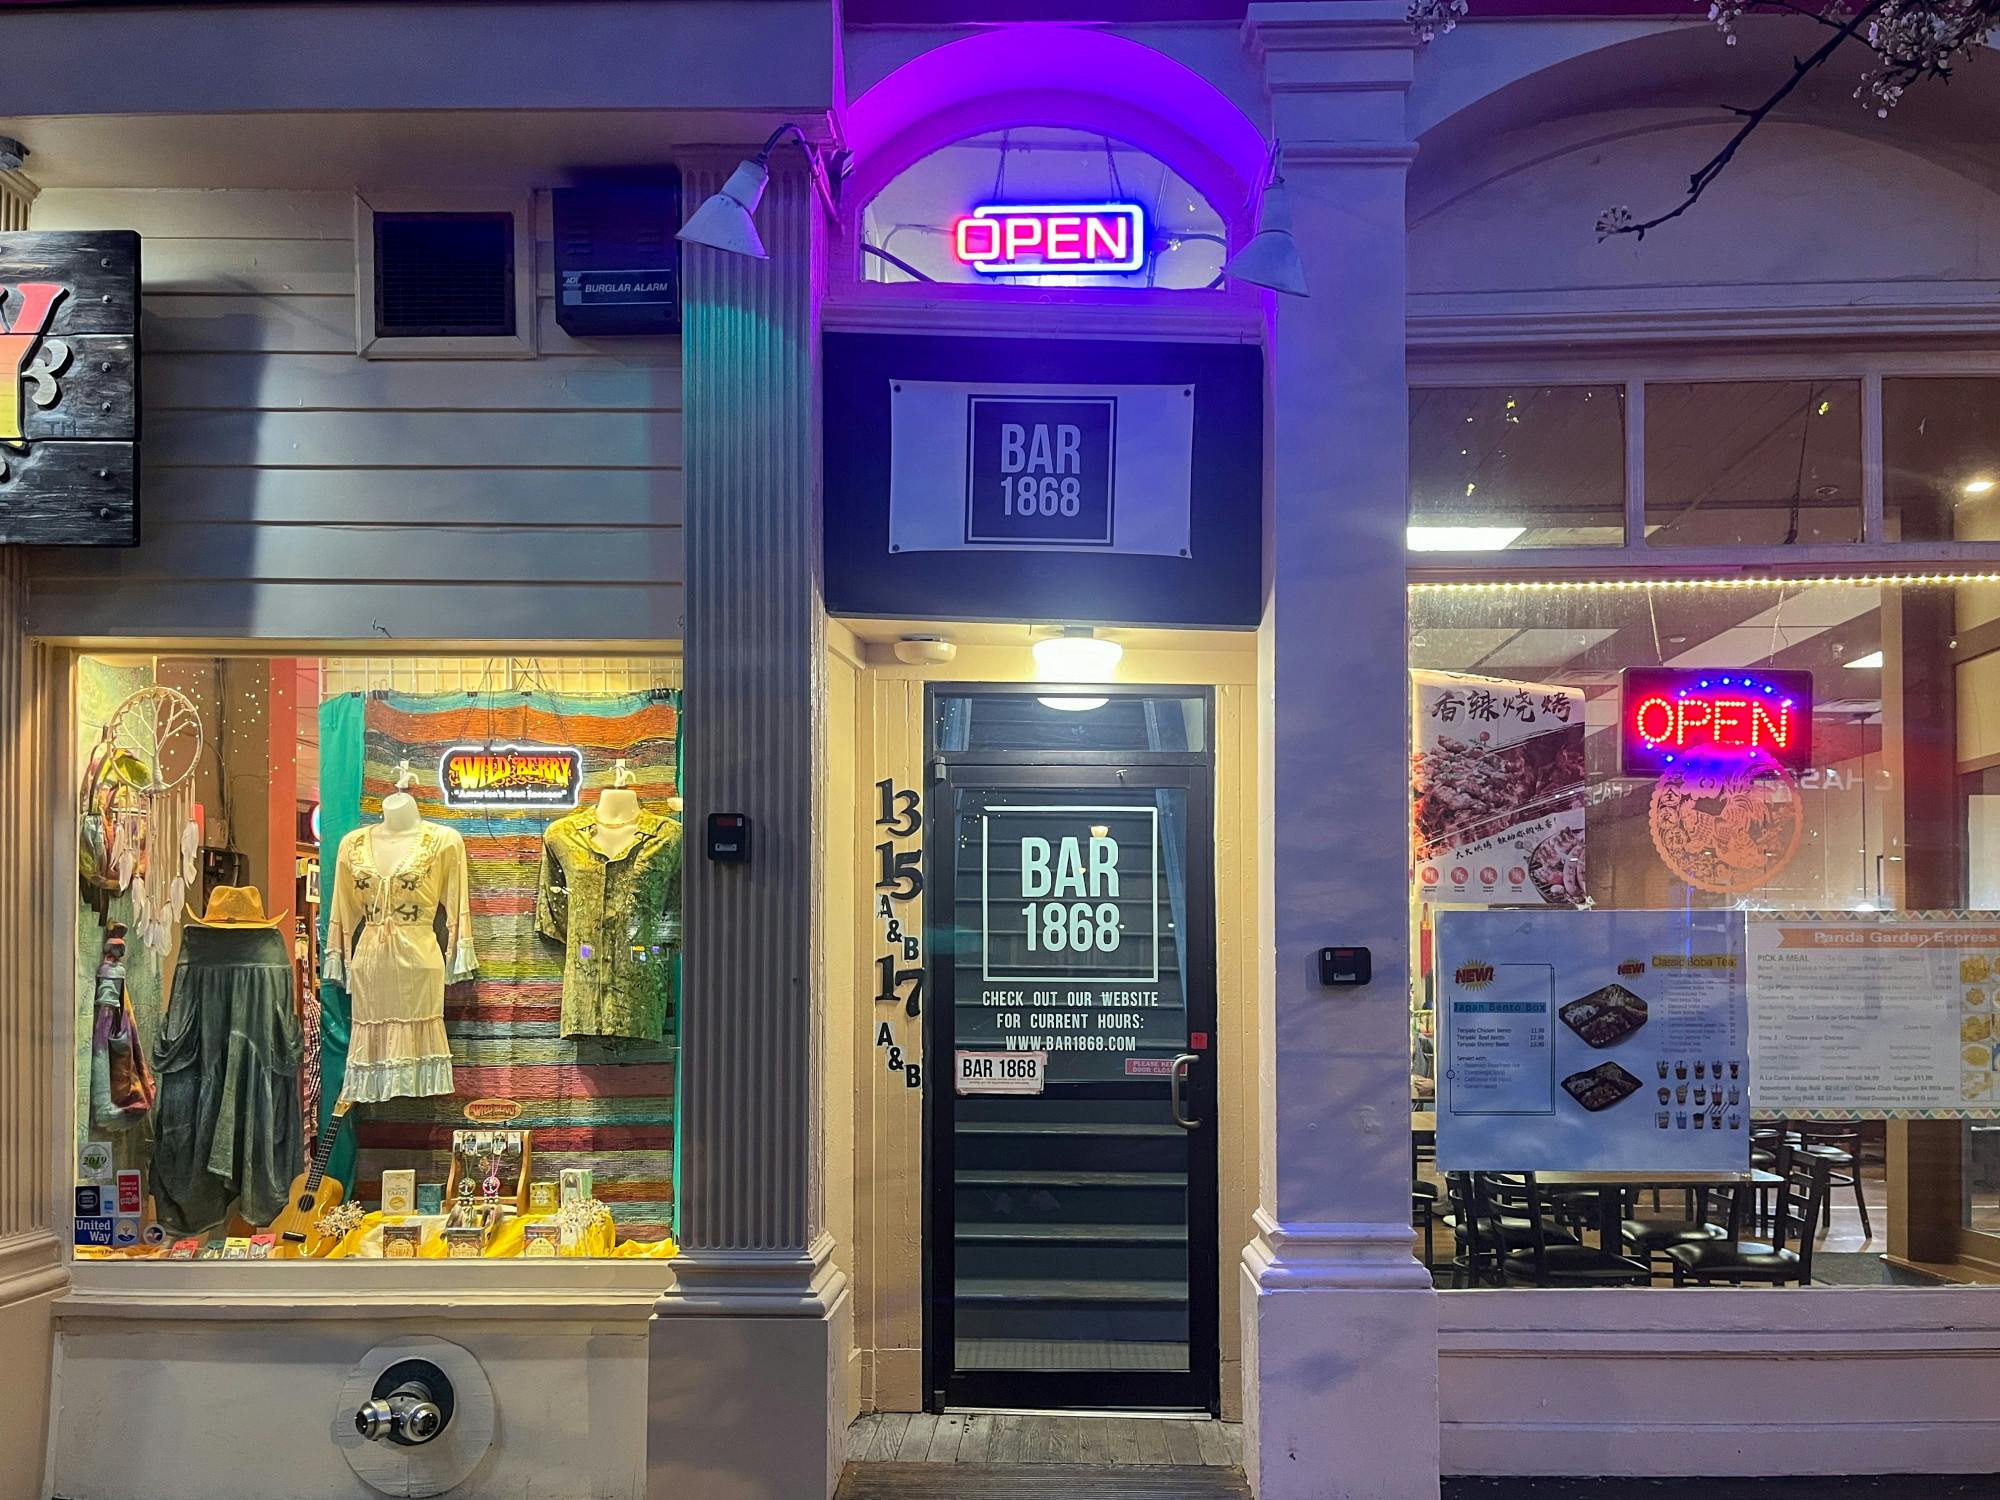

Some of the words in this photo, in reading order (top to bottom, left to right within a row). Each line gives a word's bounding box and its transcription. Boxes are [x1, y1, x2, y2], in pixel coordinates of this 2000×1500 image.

[956, 216, 1127, 262] OPEN
[585, 283, 632, 293] BURGLAR
[634, 283, 668, 292] ALARM
[1001, 423, 1081, 475] BAR
[1000, 476, 1080, 516] 1868
[1431, 688, 1571, 723] 香辣烧烤
[1637, 698, 1787, 748] OPEN
[450, 756, 511, 789] WILD
[513, 757, 572, 788] BERRY
[875, 778, 922, 837] 13
[875, 841, 924, 900] 15
[1021, 836, 1120, 897] BAR
[1021, 902, 1120, 952] 1868
[1814, 931, 1864, 943] Panda
[1869, 931, 1929, 943] Garden
[1934, 931, 1997, 945] Express
[1455, 966, 1494, 984] NEW!
[1617, 963, 1645, 976] NEW!
[875, 954, 925, 1018] 17
[982, 990, 1024, 1007] CHECK
[1033, 991, 1058, 1007] OUT
[1067, 991, 1092, 1007] OUR
[1101, 991, 1159, 1007] WEBSITE
[1488, 1003, 1522, 1012] Bento
[1525, 1003, 1547, 1012] Box
[996, 1013, 1021, 1029] FOR
[1030, 1013, 1089, 1029] CURRENT
[1098, 1013, 1145, 1029] HOURS:
[1005, 1035, 1136, 1051] WWW.BAR1868.COM
[962, 1058, 993, 1078] BAR
[999, 1058, 1037, 1078] 1868
[83, 1155, 108, 1166] 2019
[76, 1220, 111, 1231] United
[89, 1231, 111, 1245] Way
